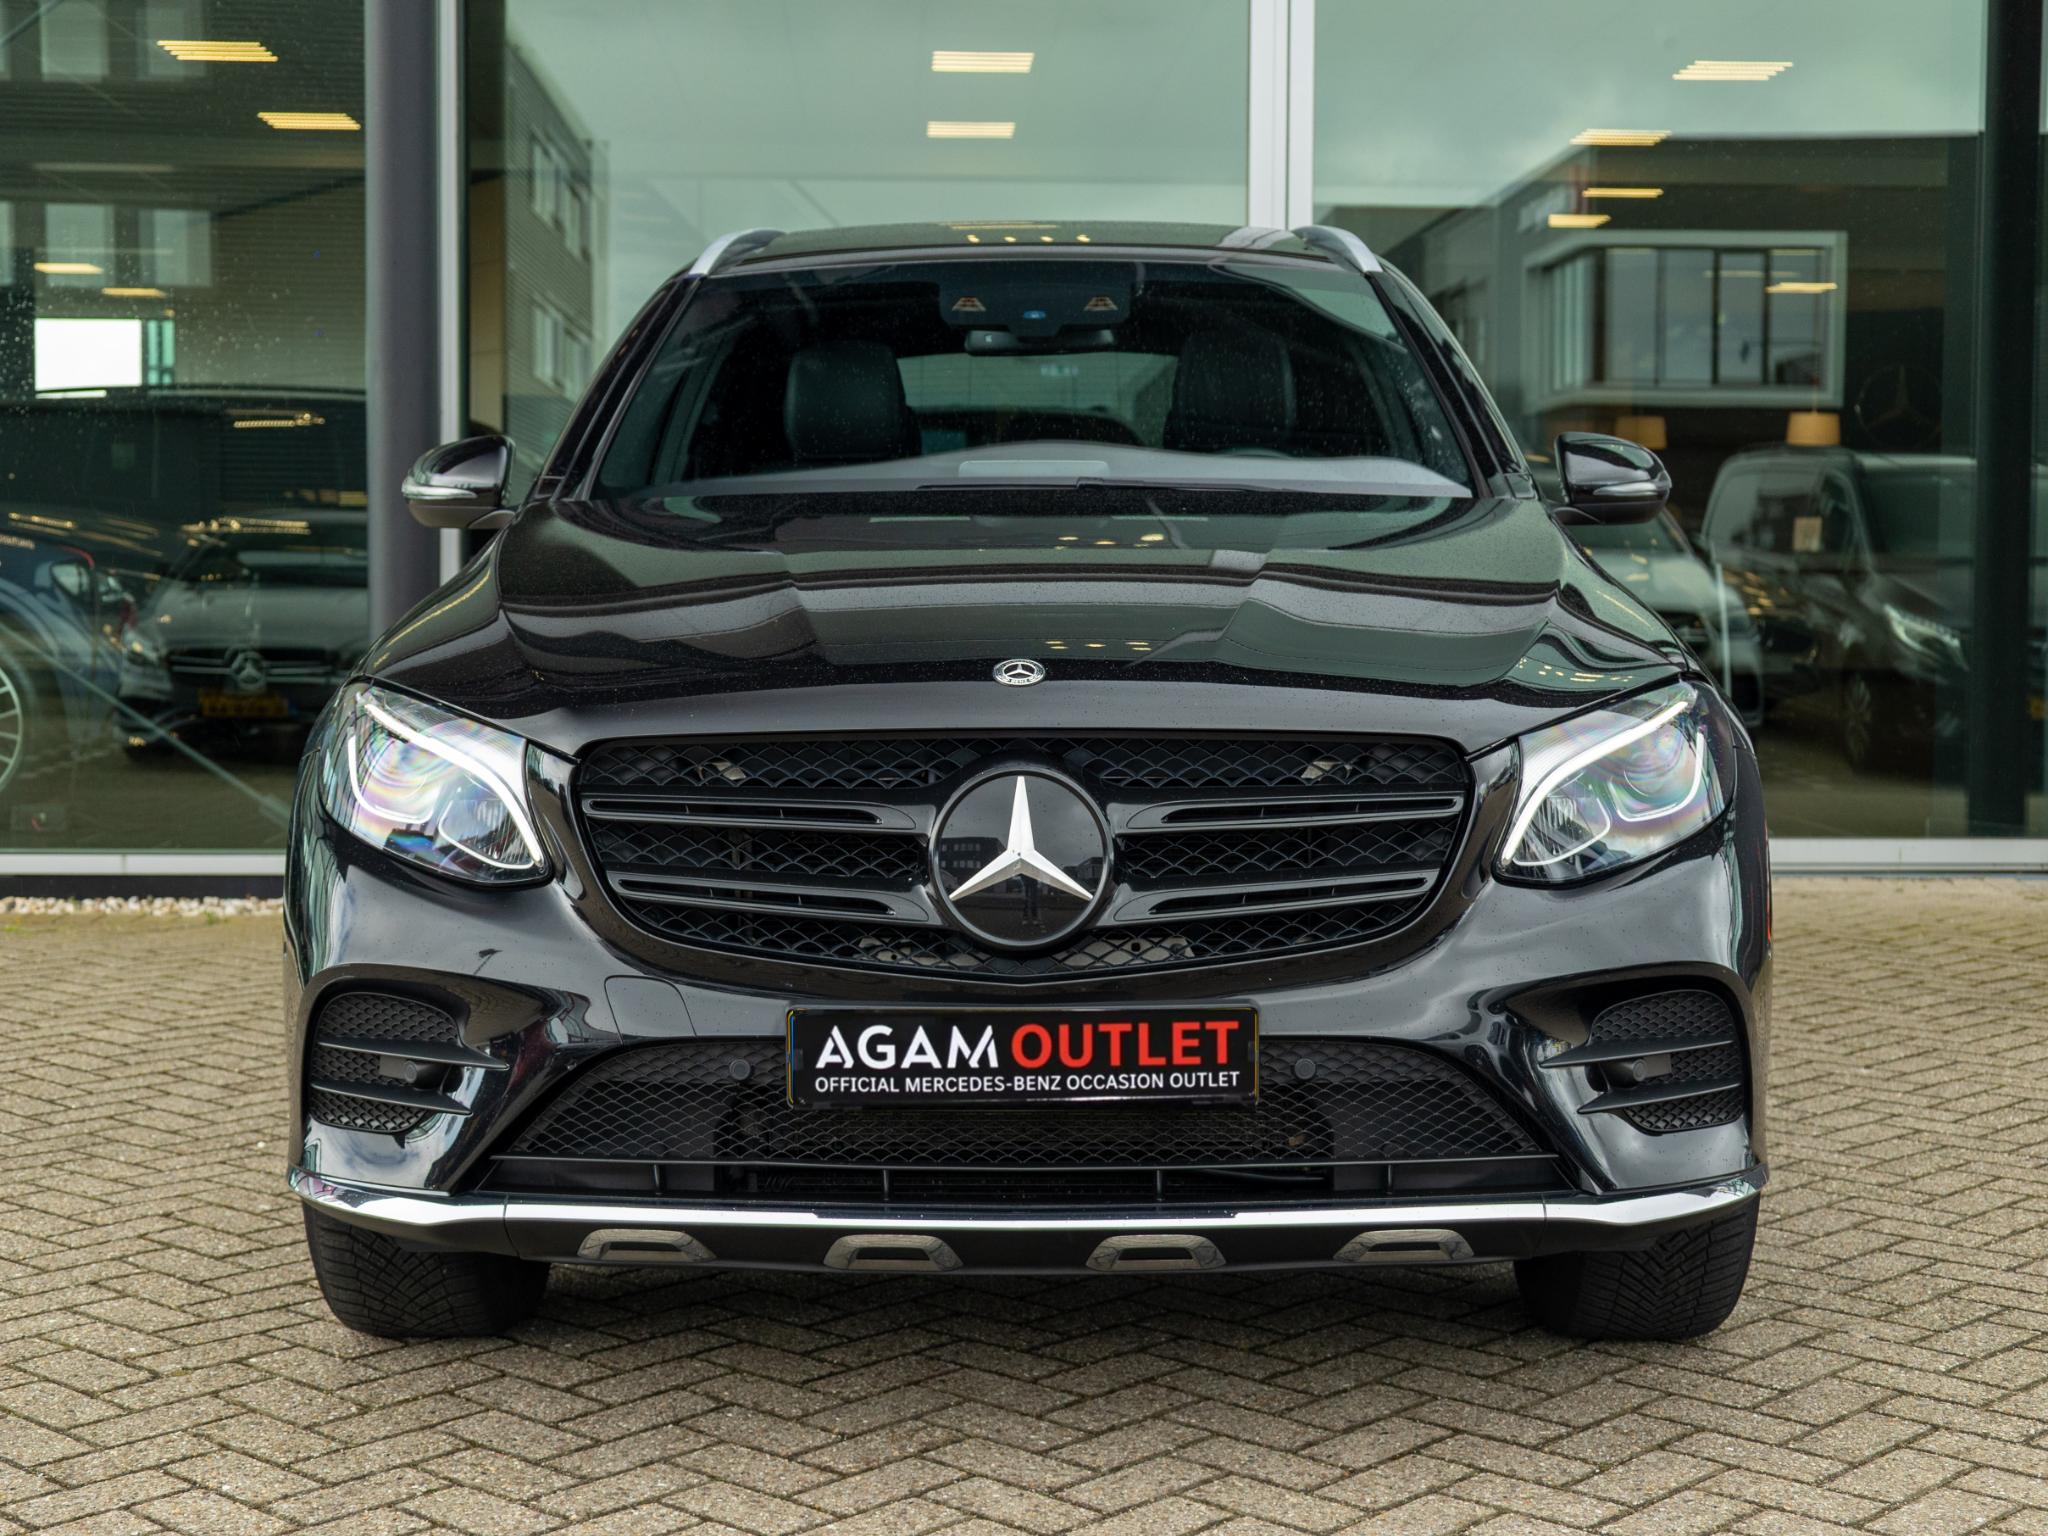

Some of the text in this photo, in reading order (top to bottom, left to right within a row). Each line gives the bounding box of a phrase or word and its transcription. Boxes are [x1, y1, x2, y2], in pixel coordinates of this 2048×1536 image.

[815, 1020, 1239, 1070] AGAM OUTLET
[815, 1070, 1240, 1093] OFFICIAL MERCEDES-BENZ OCCASION OUTLET
